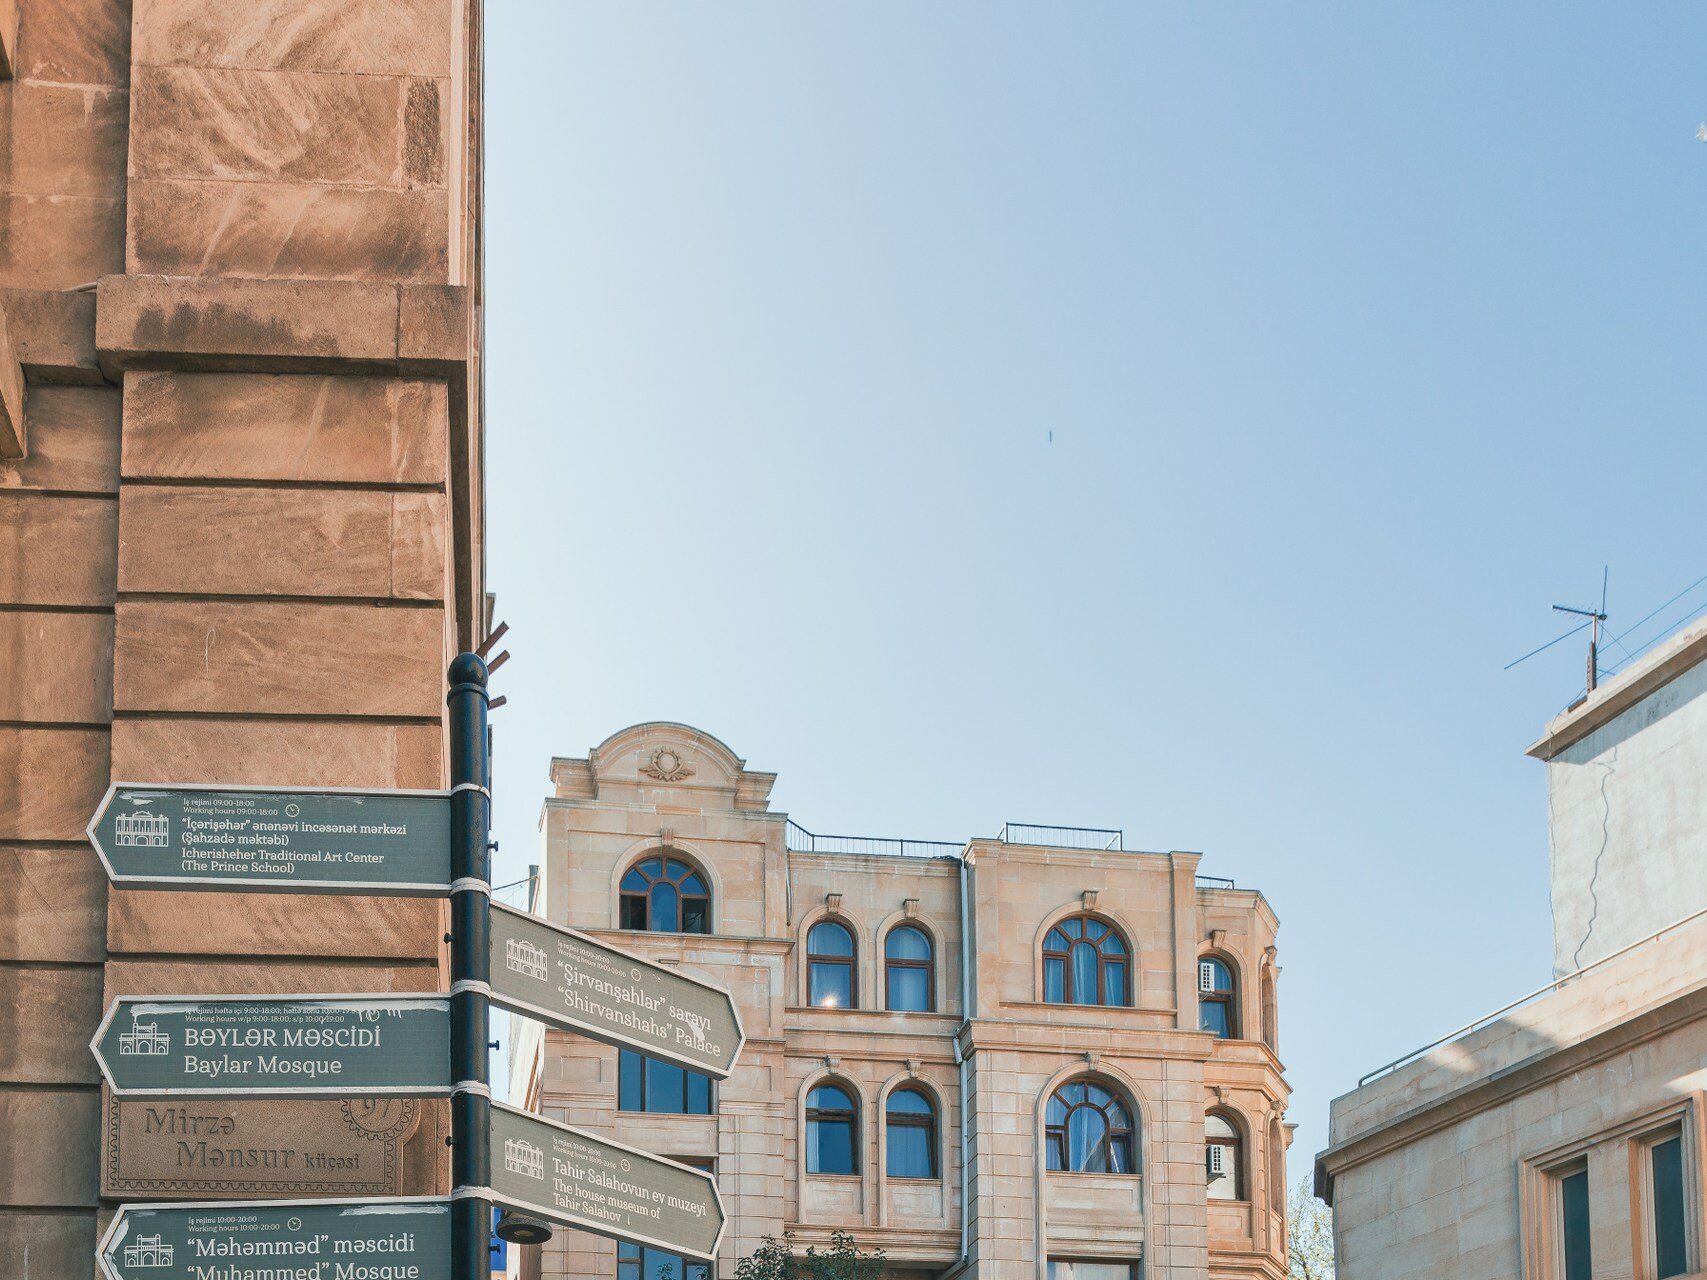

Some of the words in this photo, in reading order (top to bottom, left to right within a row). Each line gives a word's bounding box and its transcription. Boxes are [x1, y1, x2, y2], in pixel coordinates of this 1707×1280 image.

[183, 807, 214, 815] Working
[214, 807, 236, 815] hours
[236, 808, 278, 816] 09:00-18:00
[191, 799, 212, 807] rejimi
[213, 799, 255, 807] 09:00-18:00
[253, 821, 299, 832] ənənəvi
[301, 821, 358, 833] incəsənət
[360, 823, 407, 835] mərkəzi
[181, 831, 235, 845] (Şahzadə
[238, 834, 289, 846] məktəbi)
[182, 848, 256, 860] Icherisheher
[258, 850, 321, 861] Traditional
[323, 852, 342, 862] Art
[345, 852, 384, 863] Center
[181, 860, 208, 871] (The
[210, 861, 248, 872] Prince
[251, 862, 295, 874] School)
[557, 947, 580, 963] Working
[580, 955, 596, 967] hours
[185, 1015, 215, 1023] Working
[557, 985, 672, 1038] “Shirvanshahs”
[675, 1027, 721, 1057] Palace
[669, 1005, 711, 1031] sarayı
[184, 1028, 277, 1047] BƏYLƏR
[283, 1025, 381, 1047] MƏSCİDİ
[184, 1054, 252, 1078] Baylar
[257, 1055, 342, 1078] Mosque
[144, 1108, 235, 1134] Mirzə
[175, 1141, 295, 1168] Mənsur
[552, 1144, 574, 1157] Working
[574, 1151, 589, 1160] hours
[552, 1157, 586, 1180] Tahir
[588, 1168, 650, 1200] Salahovun
[652, 1191, 666, 1204] ev
[667, 1195, 706, 1218] muzeyi
[552, 1177, 573, 1194] The
[575, 1183, 606, 1204] house
[607, 1196, 649, 1216] museum
[650, 1207, 661, 1219] of
[552, 1192, 581, 1211] Tahir
[582, 1201, 621, 1222] Salahov
[188, 1225, 218, 1233] Working
[195, 1217, 216, 1225] rejimi
[333, 1233, 415, 1254] məscidi
